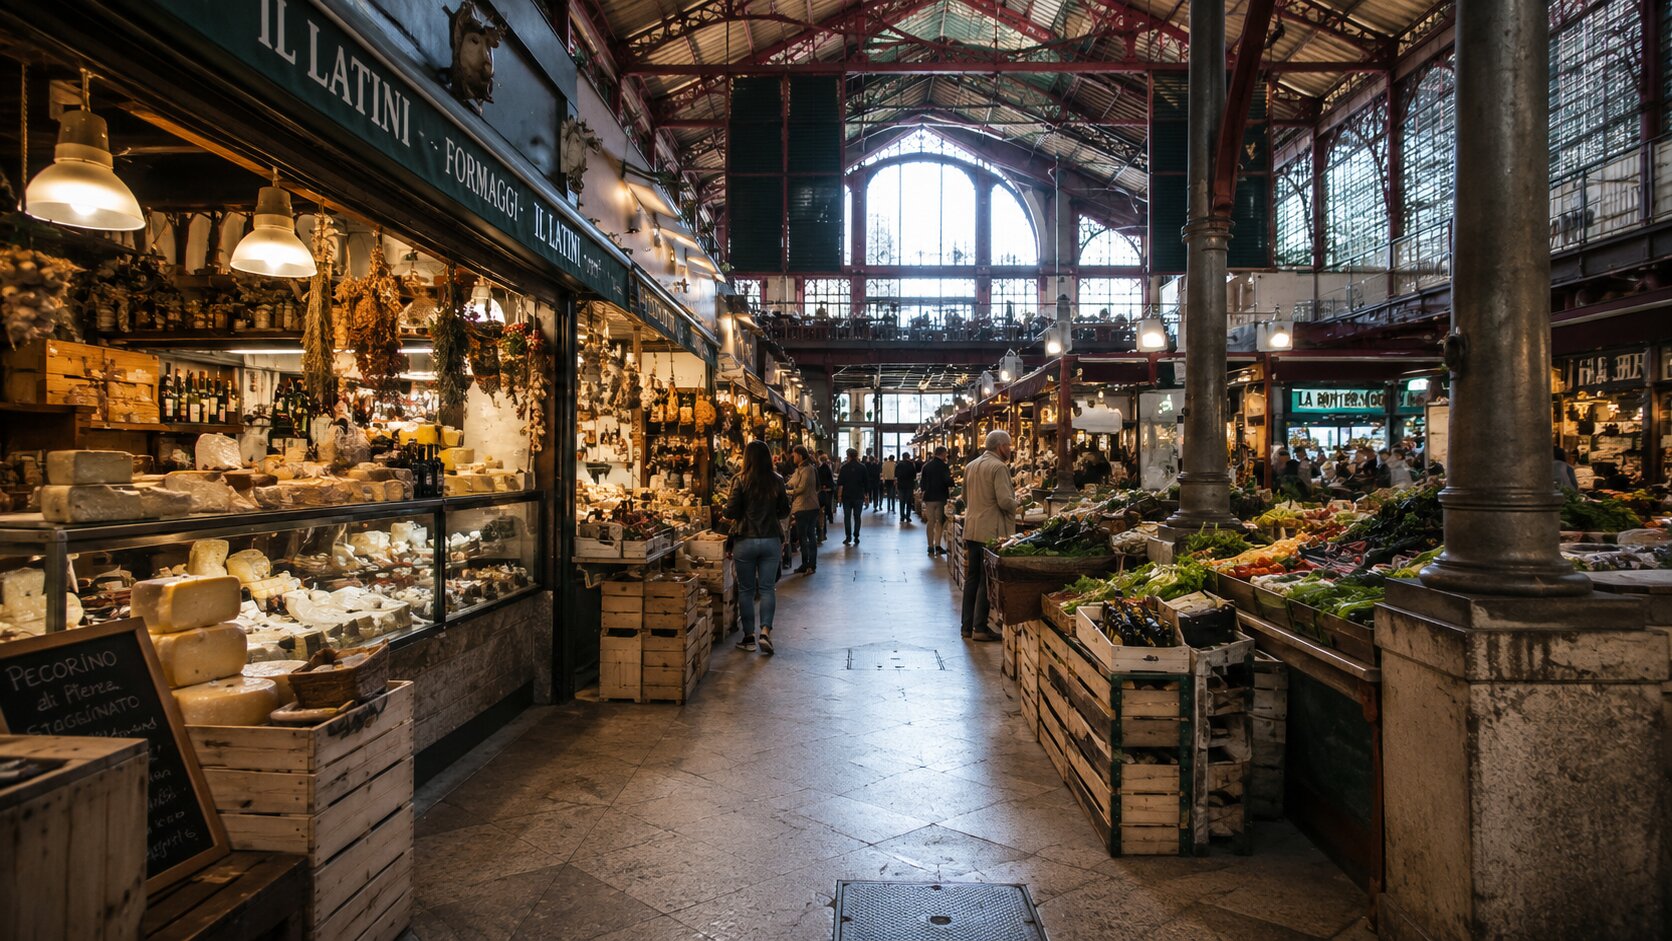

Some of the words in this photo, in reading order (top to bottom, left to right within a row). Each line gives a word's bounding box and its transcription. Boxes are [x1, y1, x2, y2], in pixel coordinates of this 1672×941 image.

[258, 0, 296, 65] IL
[307, 18, 411, 148] LATINI
[445, 136, 519, 222] FORMAGGI
[534, 202, 546, 242] IL
[548, 214, 581, 268] LATINI
[5, 650, 118, 692] PECORINO
